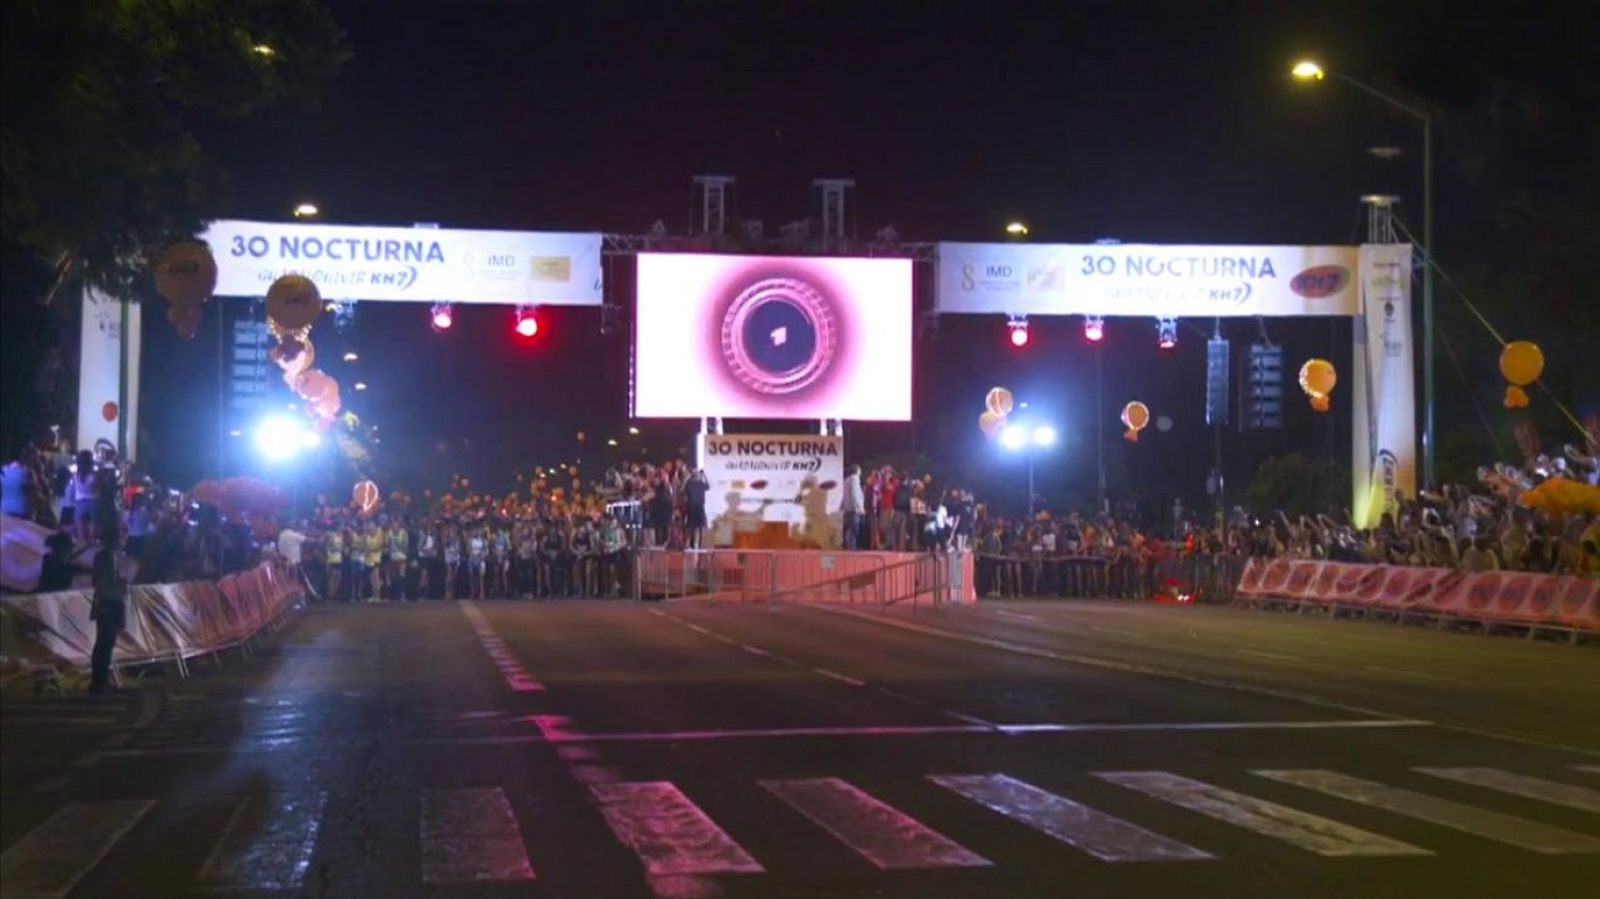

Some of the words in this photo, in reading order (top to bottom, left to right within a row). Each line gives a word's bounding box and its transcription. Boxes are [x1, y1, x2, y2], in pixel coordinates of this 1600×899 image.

[230, 235, 269, 258] 30
[279, 236, 445, 264] NOCTURNA
[487, 254, 516, 268] IMD
[1081, 254, 1117, 276] 30
[1125, 256, 1277, 279] NOCTURNA
[370, 269, 412, 288] KH7
[985, 264, 1013, 279] IMD
[1208, 285, 1247, 302] KH7
[737, 441, 838, 457] NOCTURNA
